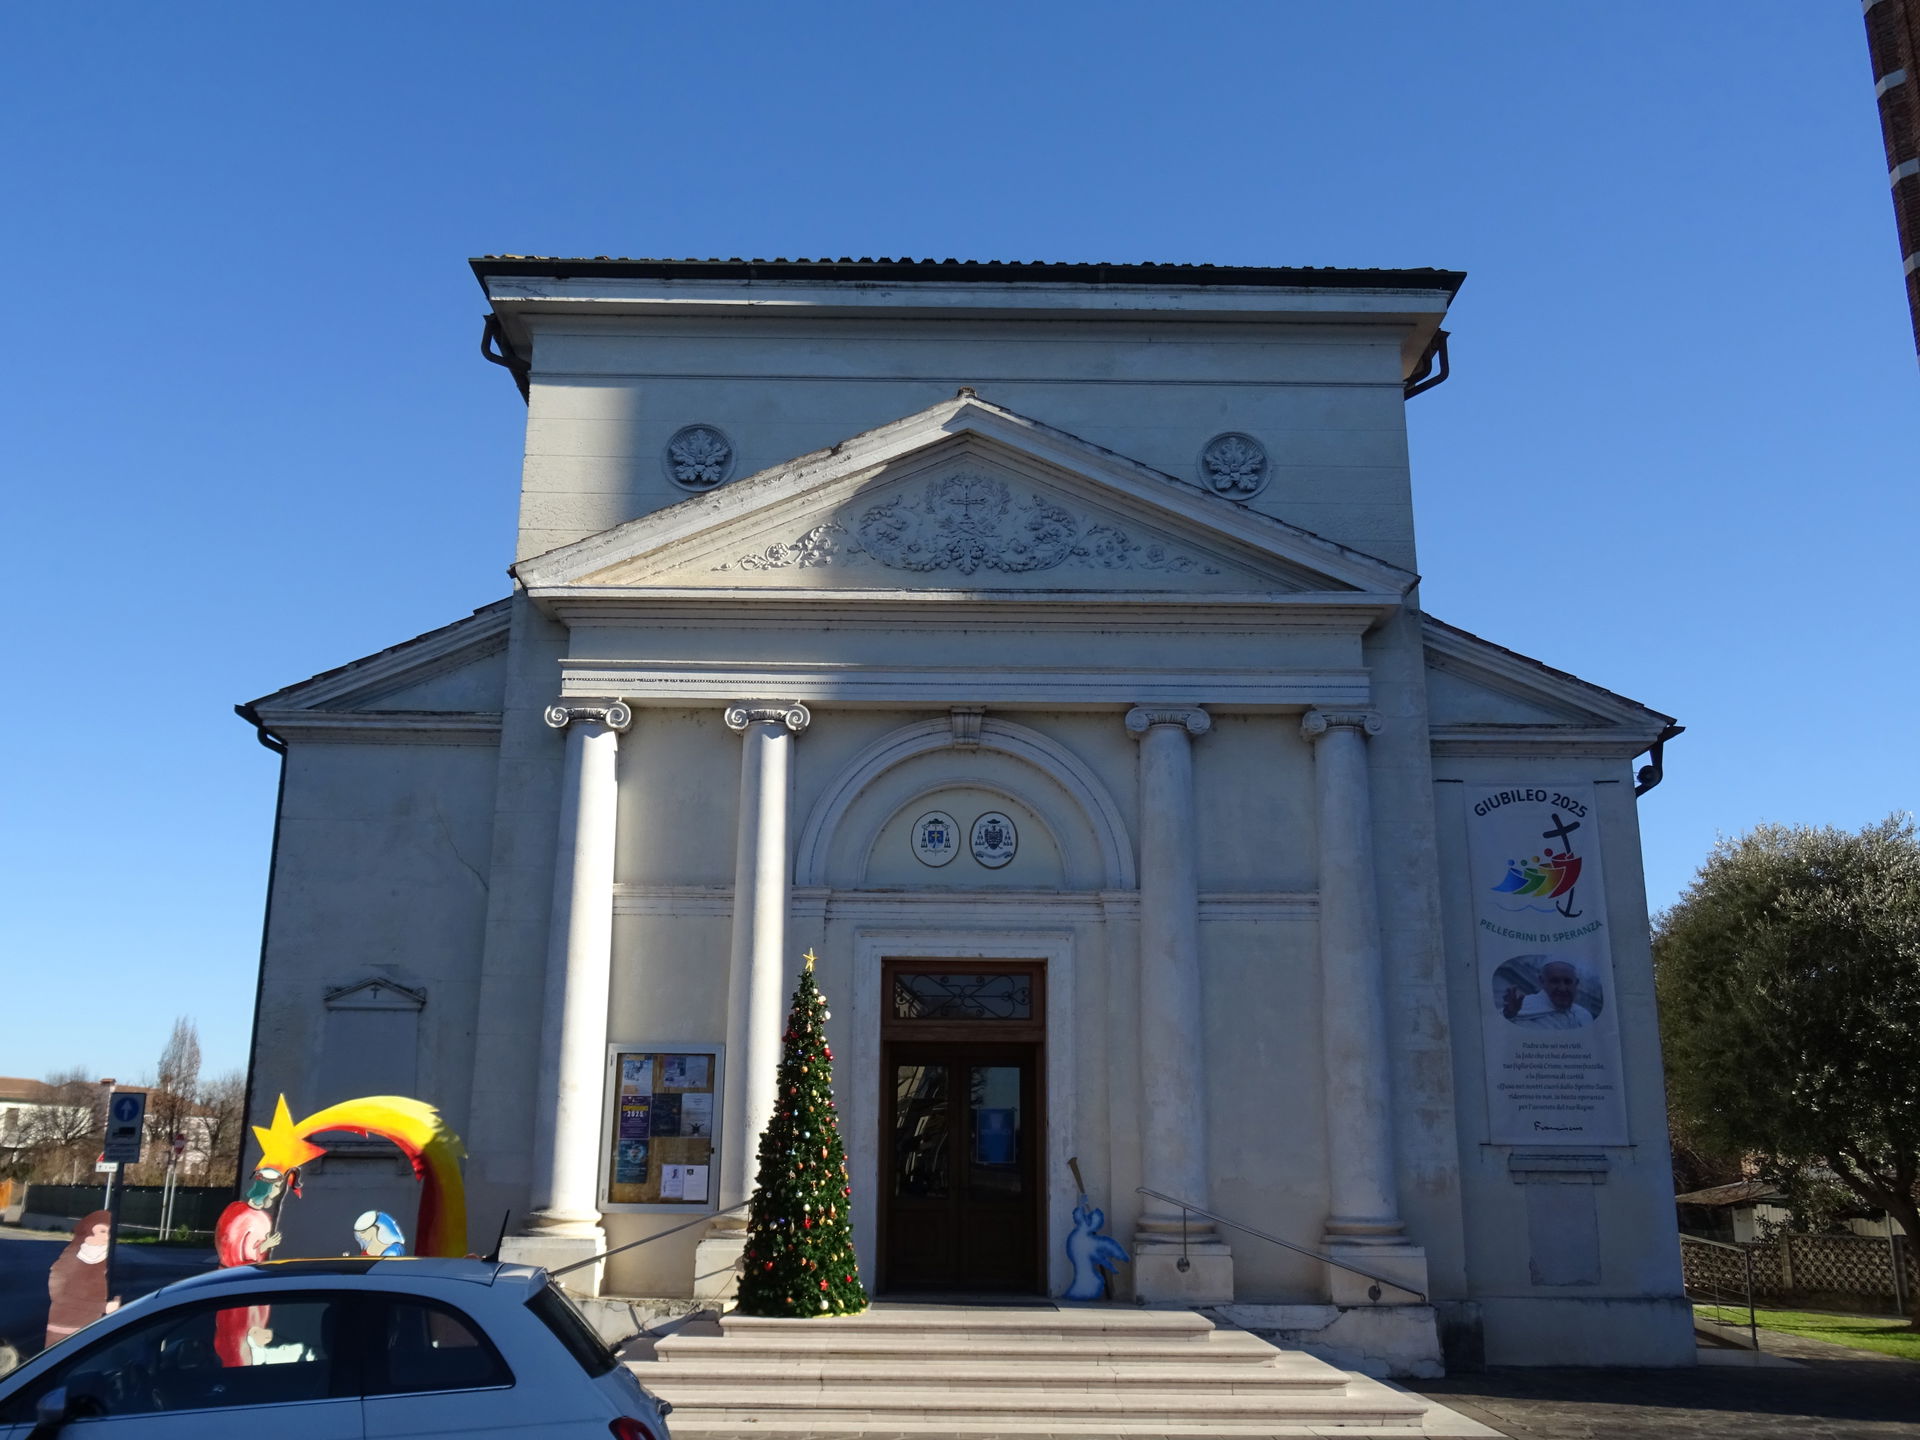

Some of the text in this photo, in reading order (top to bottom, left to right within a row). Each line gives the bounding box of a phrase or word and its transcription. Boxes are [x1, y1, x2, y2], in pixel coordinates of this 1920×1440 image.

[1474, 789, 1588, 818] GIUBILEO 2025
[1479, 918, 1603, 943] PELLEGRINI DI SPERANZA
